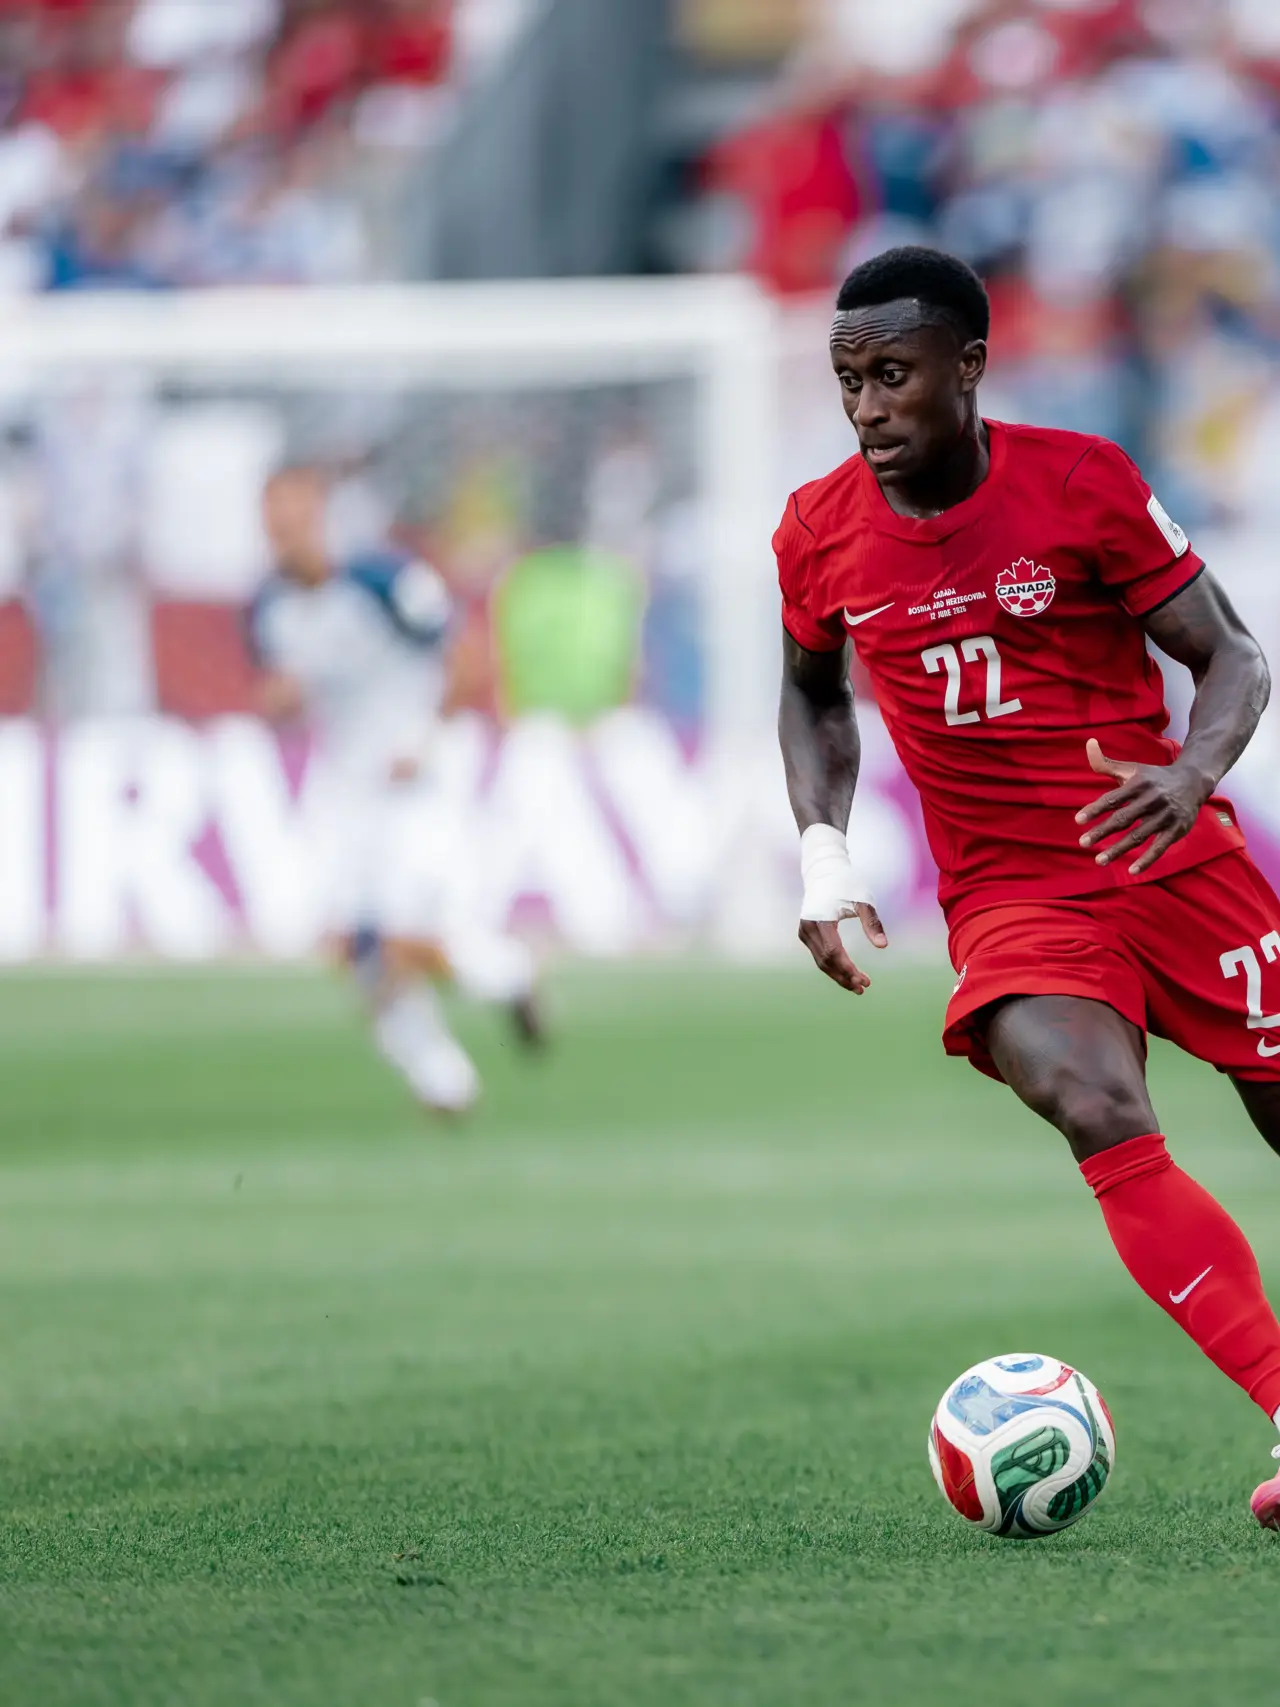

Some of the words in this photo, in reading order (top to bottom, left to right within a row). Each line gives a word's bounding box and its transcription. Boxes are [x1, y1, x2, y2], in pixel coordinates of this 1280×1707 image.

[933, 587, 956, 599] CANADA
[997, 581, 1054, 596] CANADA
[908, 604, 931, 615] BOSNIA
[932, 600, 945, 610] AND
[945, 591, 987, 607] HERZEGOVINA
[930, 612, 936, 620] 12
[937, 608, 952, 618] JUNE
[952, 605, 967, 615] 2026
[921, 635, 1023, 726] 22
